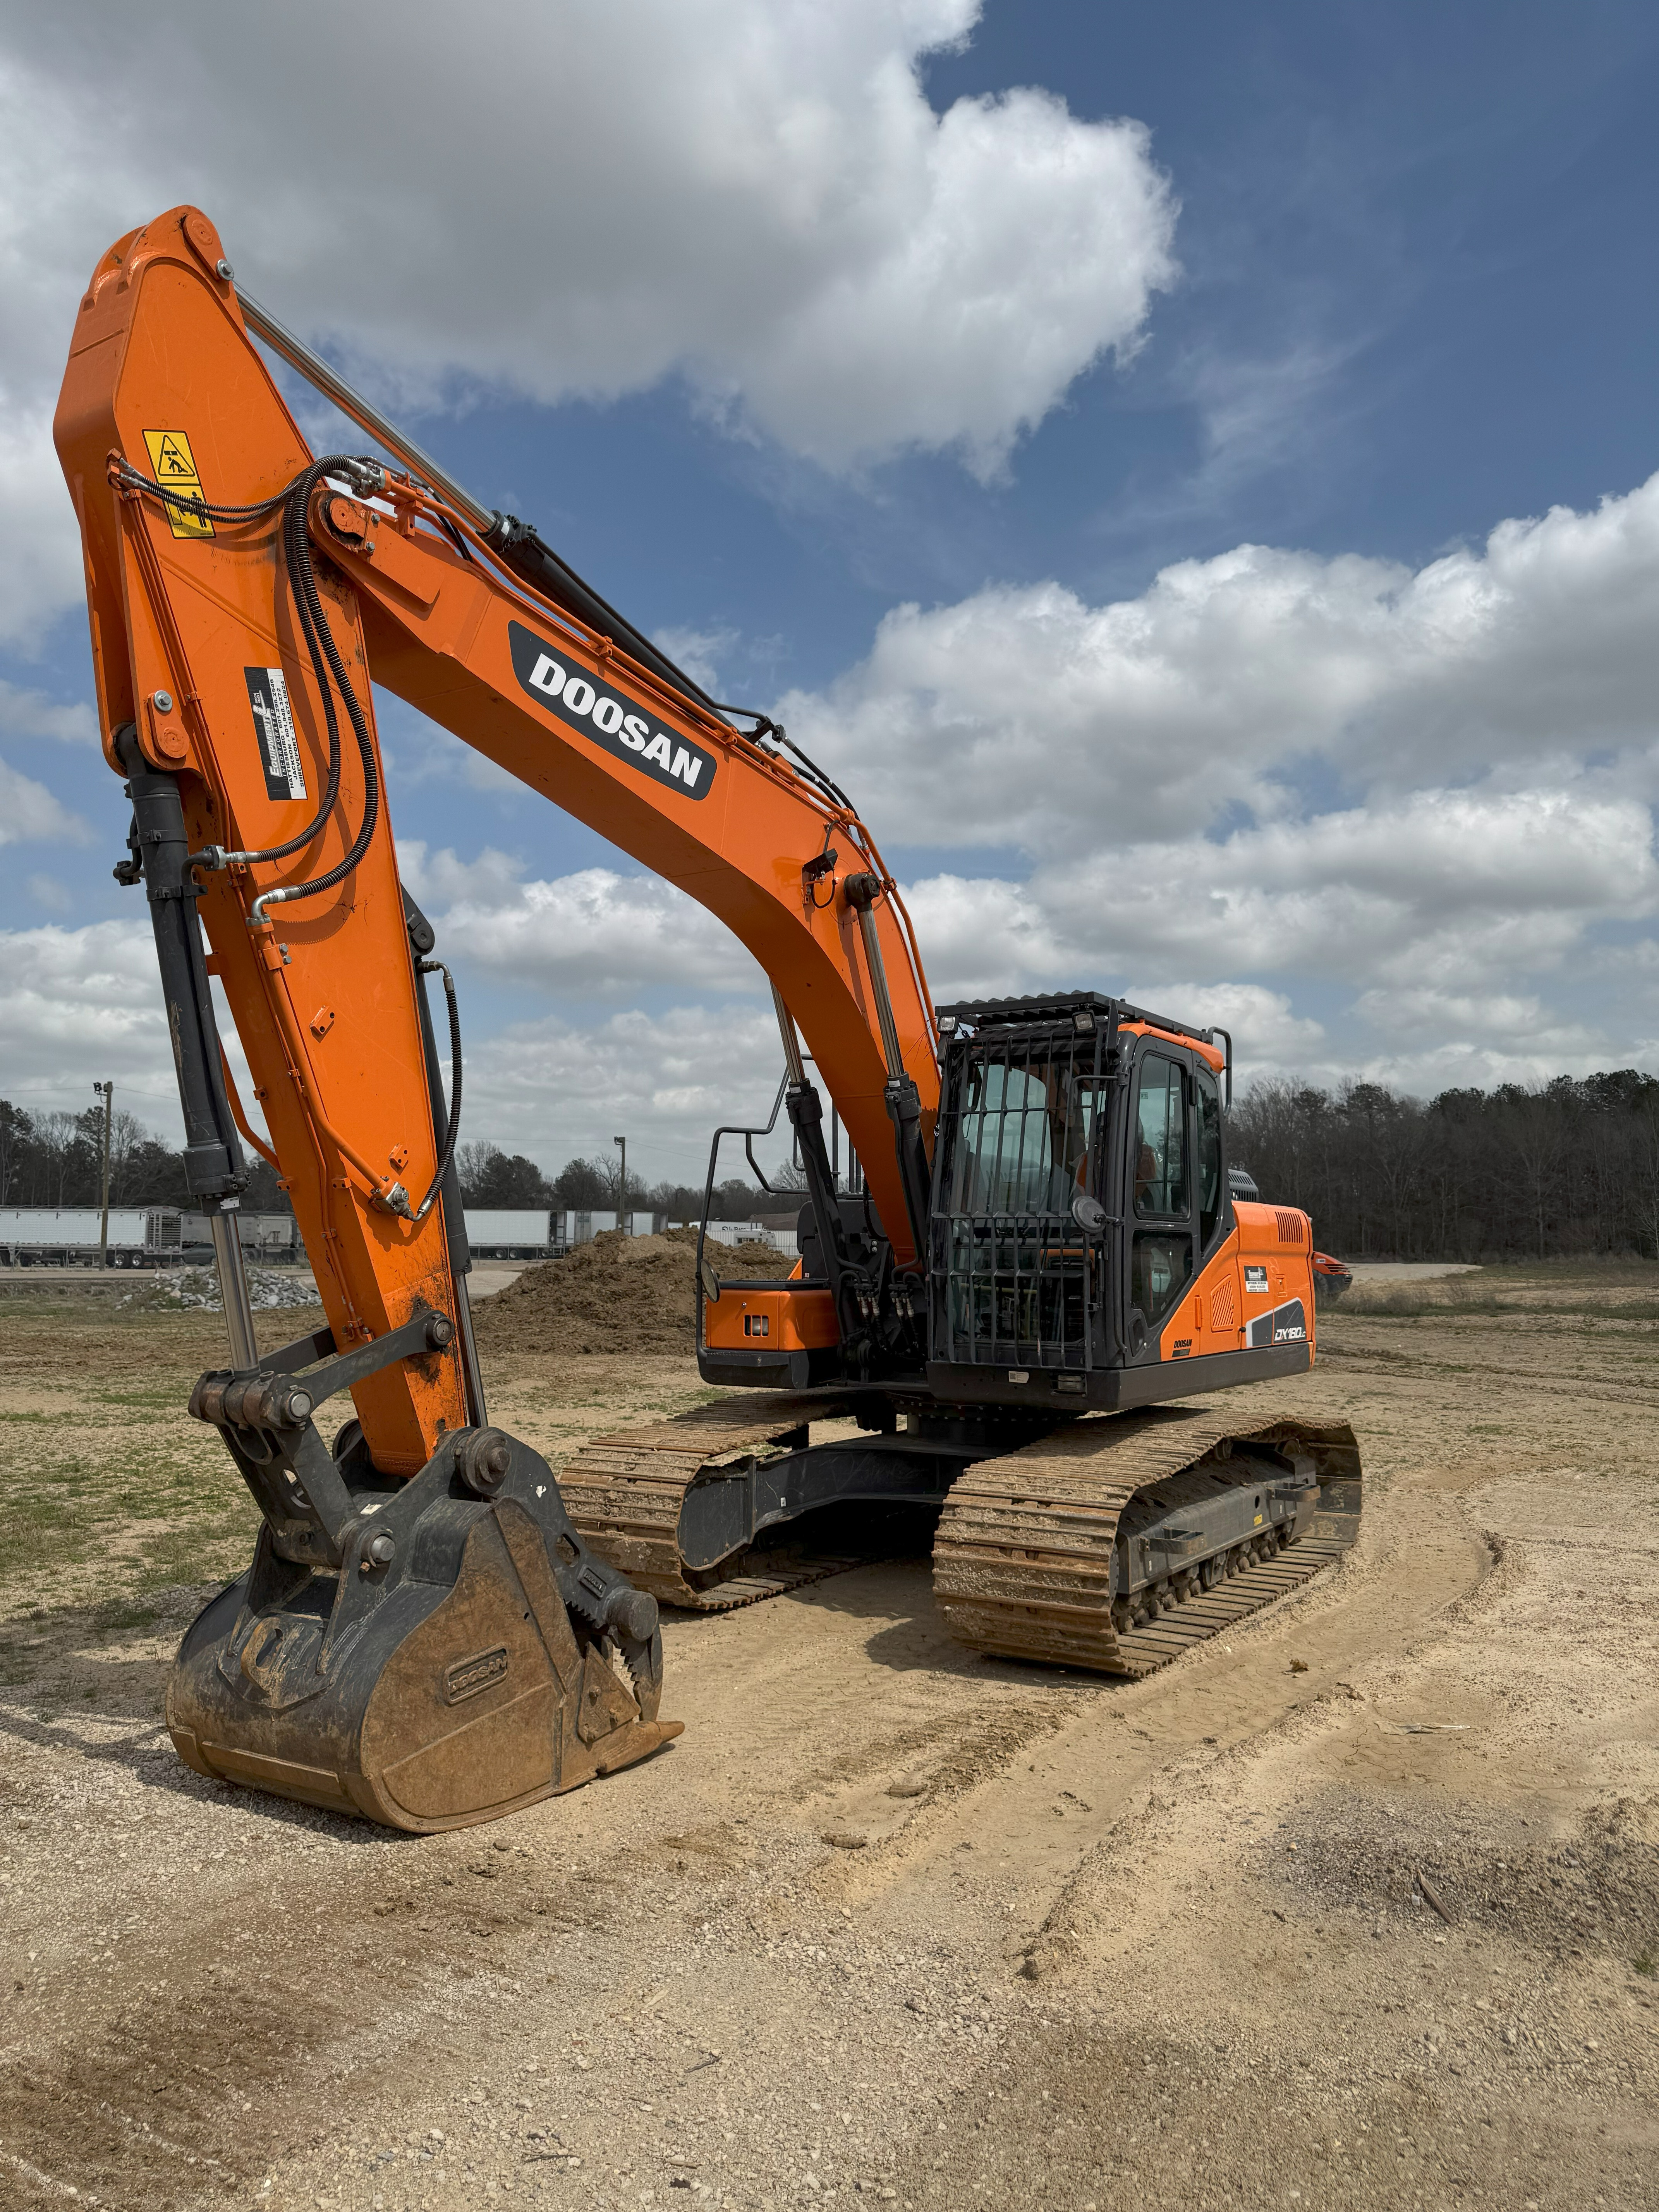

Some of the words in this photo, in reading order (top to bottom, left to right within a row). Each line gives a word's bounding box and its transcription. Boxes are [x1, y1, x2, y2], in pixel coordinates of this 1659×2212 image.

[270, 679, 283, 729] 601.296.2546
[528, 653, 703, 788] DOOSAN
[263, 716, 282, 776] EQUIPMENT
[270, 709, 287, 777] INCORPORATED
[280, 735, 294, 789] HATTIESBURG
[287, 744, 298, 780] JACKSON
[291, 736, 304, 787] SHREVEPORT
[1173, 1339, 1193, 1348] DOOSAN
[448, 1655, 508, 1696] DOOSAN
